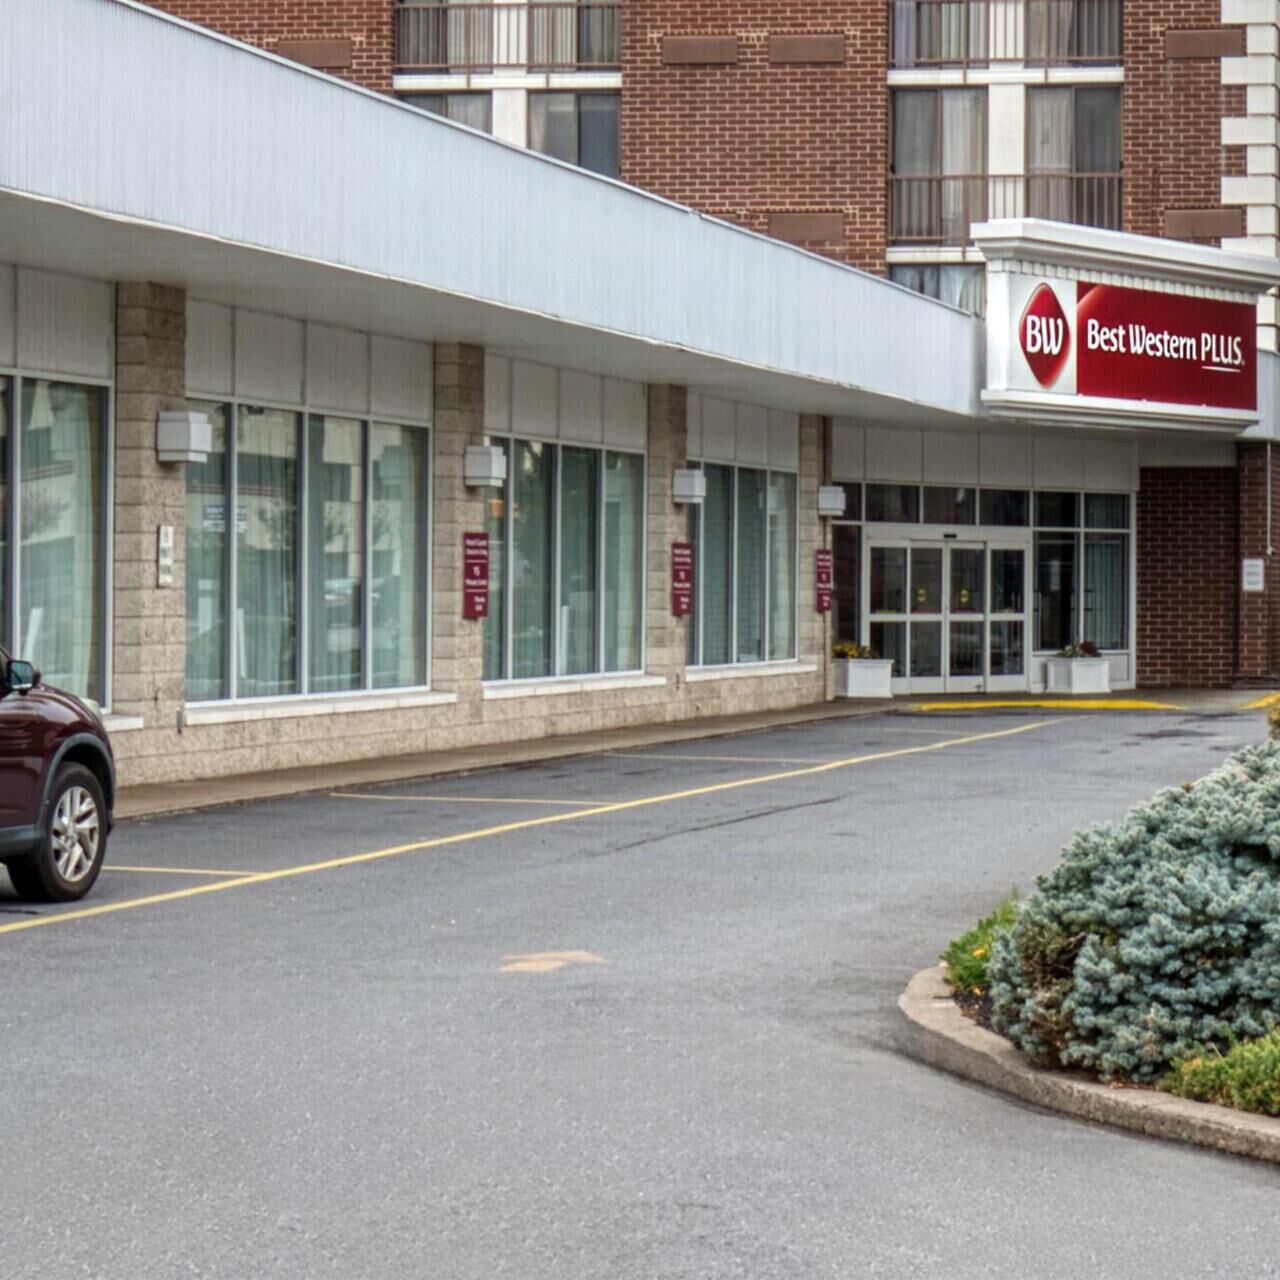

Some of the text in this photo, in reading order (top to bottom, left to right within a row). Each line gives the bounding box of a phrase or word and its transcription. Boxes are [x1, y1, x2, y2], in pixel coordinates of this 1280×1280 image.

[1026, 314, 1063, 356] BW
[1087, 318, 1126, 352] Best
[1129, 324, 1197, 361] Western
